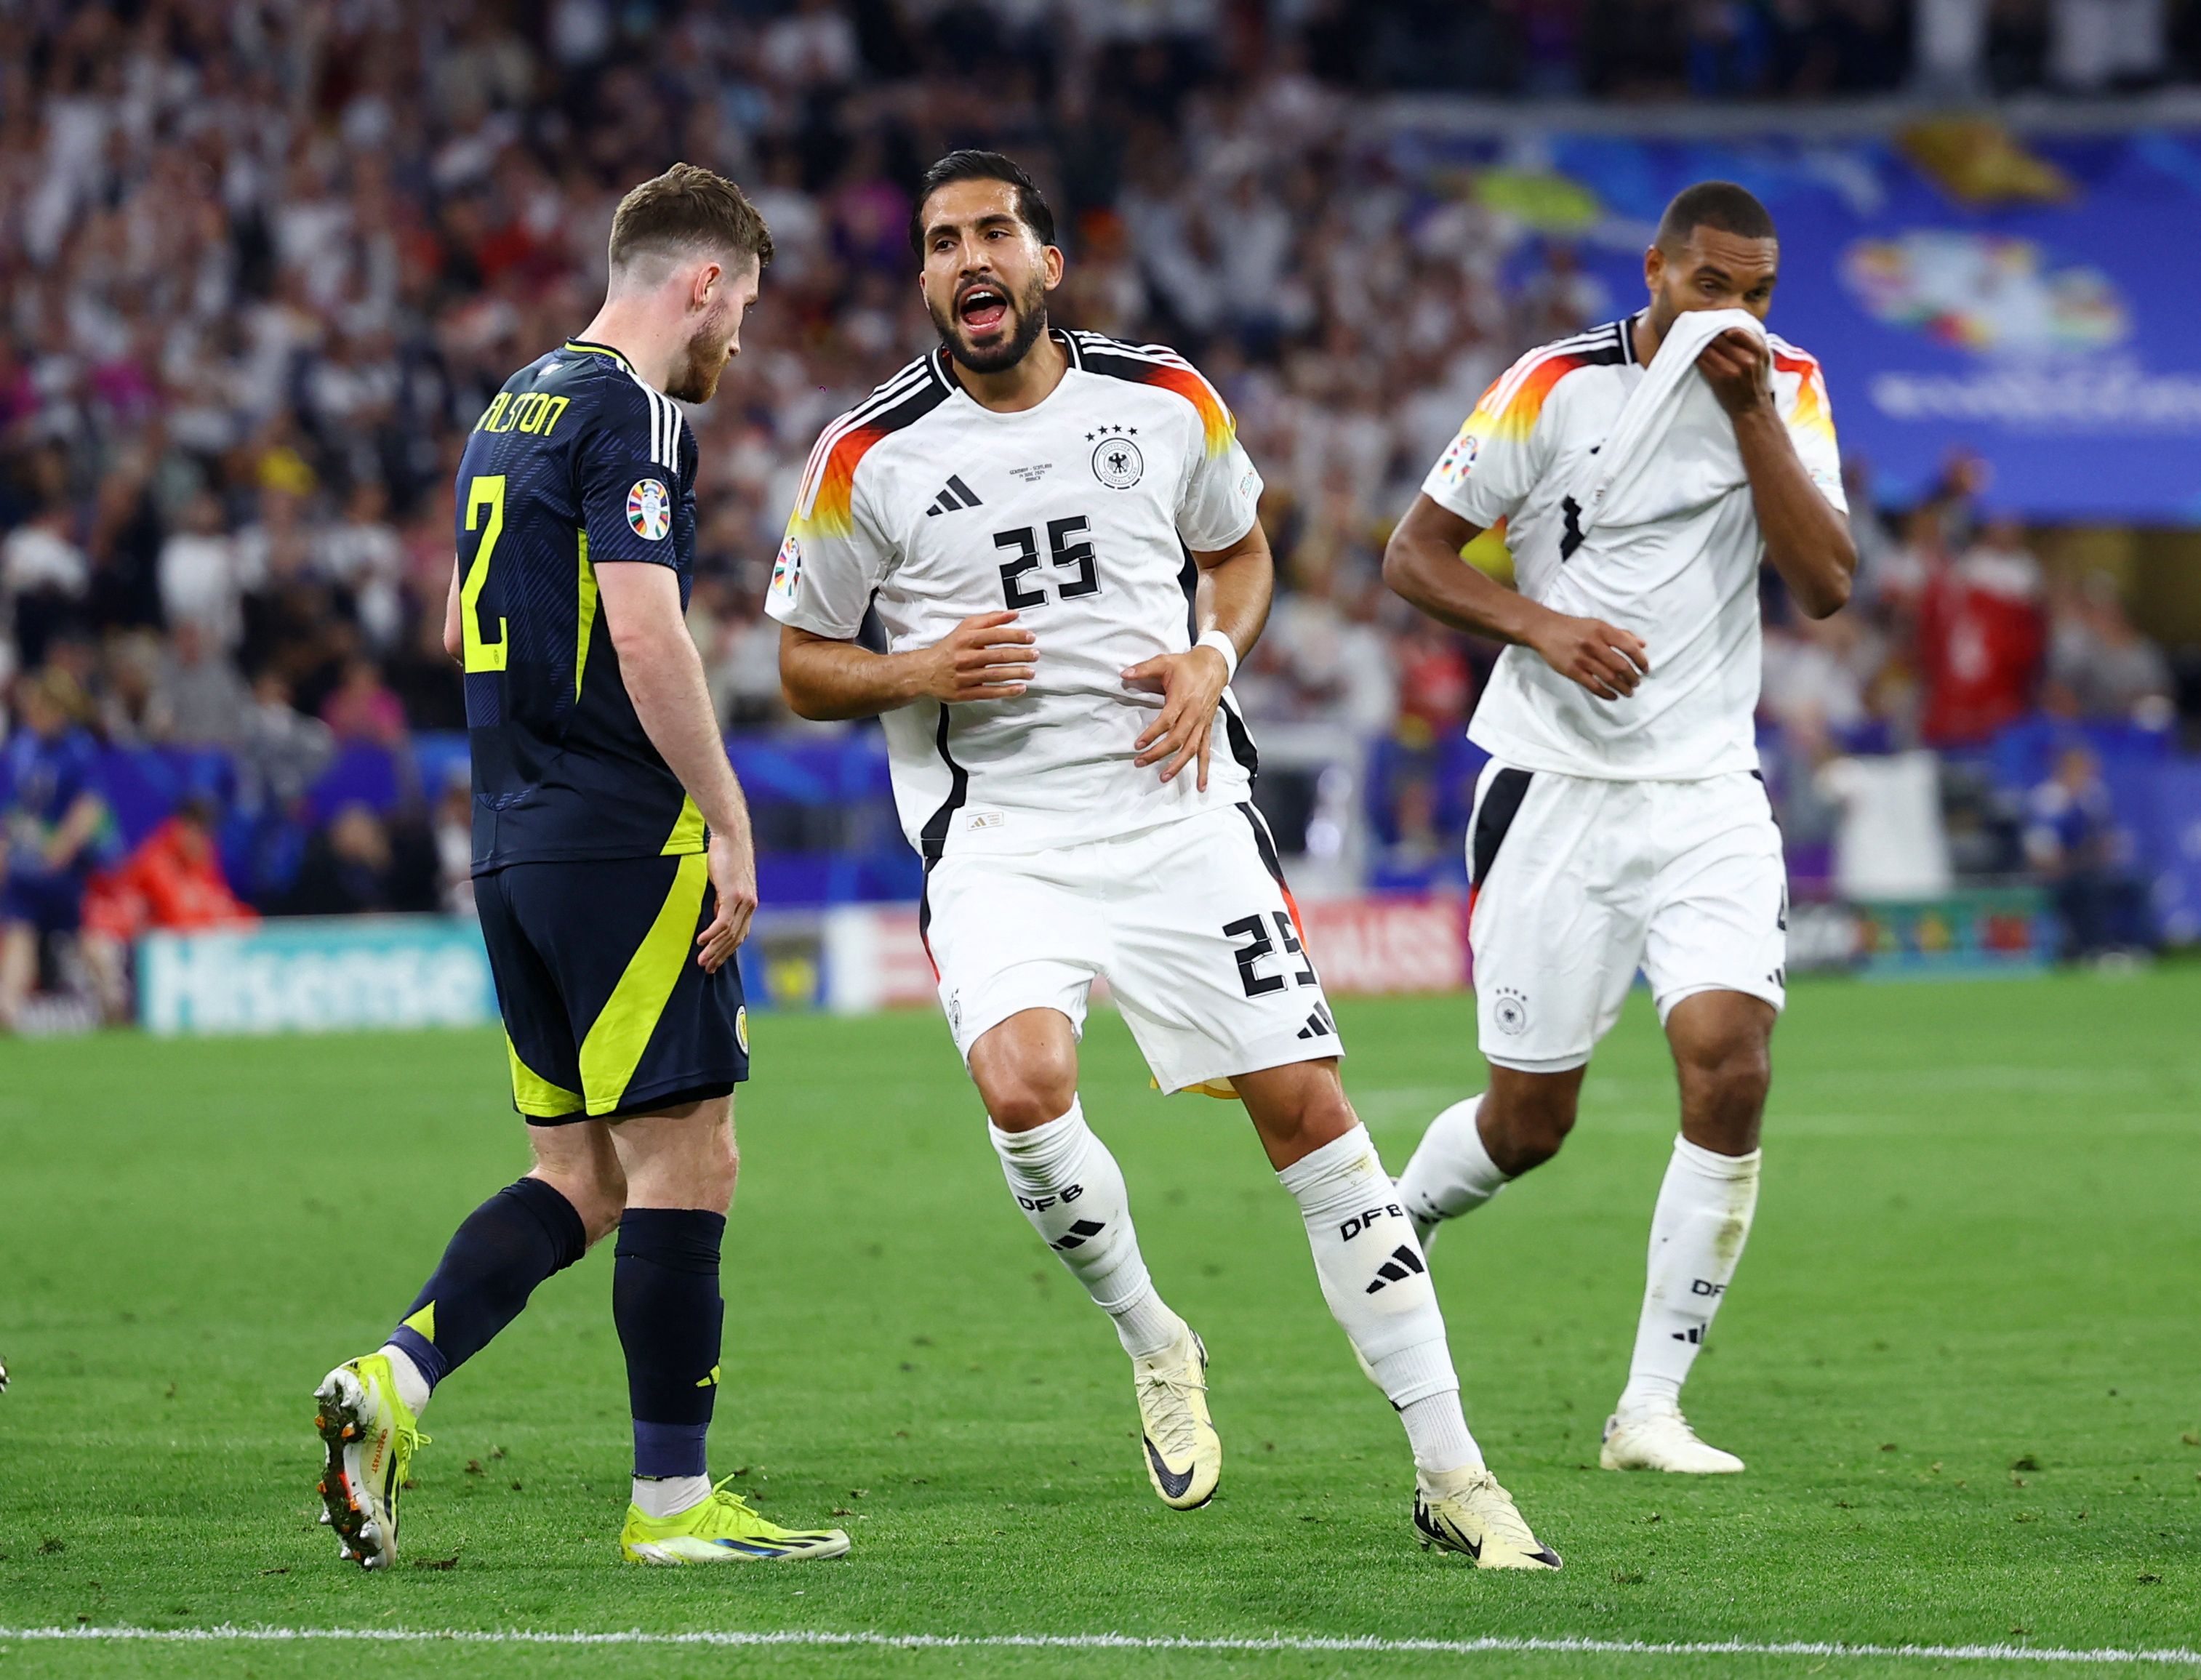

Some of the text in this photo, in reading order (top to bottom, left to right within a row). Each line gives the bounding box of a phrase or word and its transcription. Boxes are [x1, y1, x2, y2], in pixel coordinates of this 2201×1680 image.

[473, 391, 570, 436] ALSTON
[460, 475, 507, 673] 2
[993, 515, 1102, 612] 25
[1222, 911, 1320, 998] 25
[1017, 1183, 1083, 1213] DFB
[1340, 1203, 1404, 1242] DFB
[371, 1428, 388, 1474] CRAZYFAST
